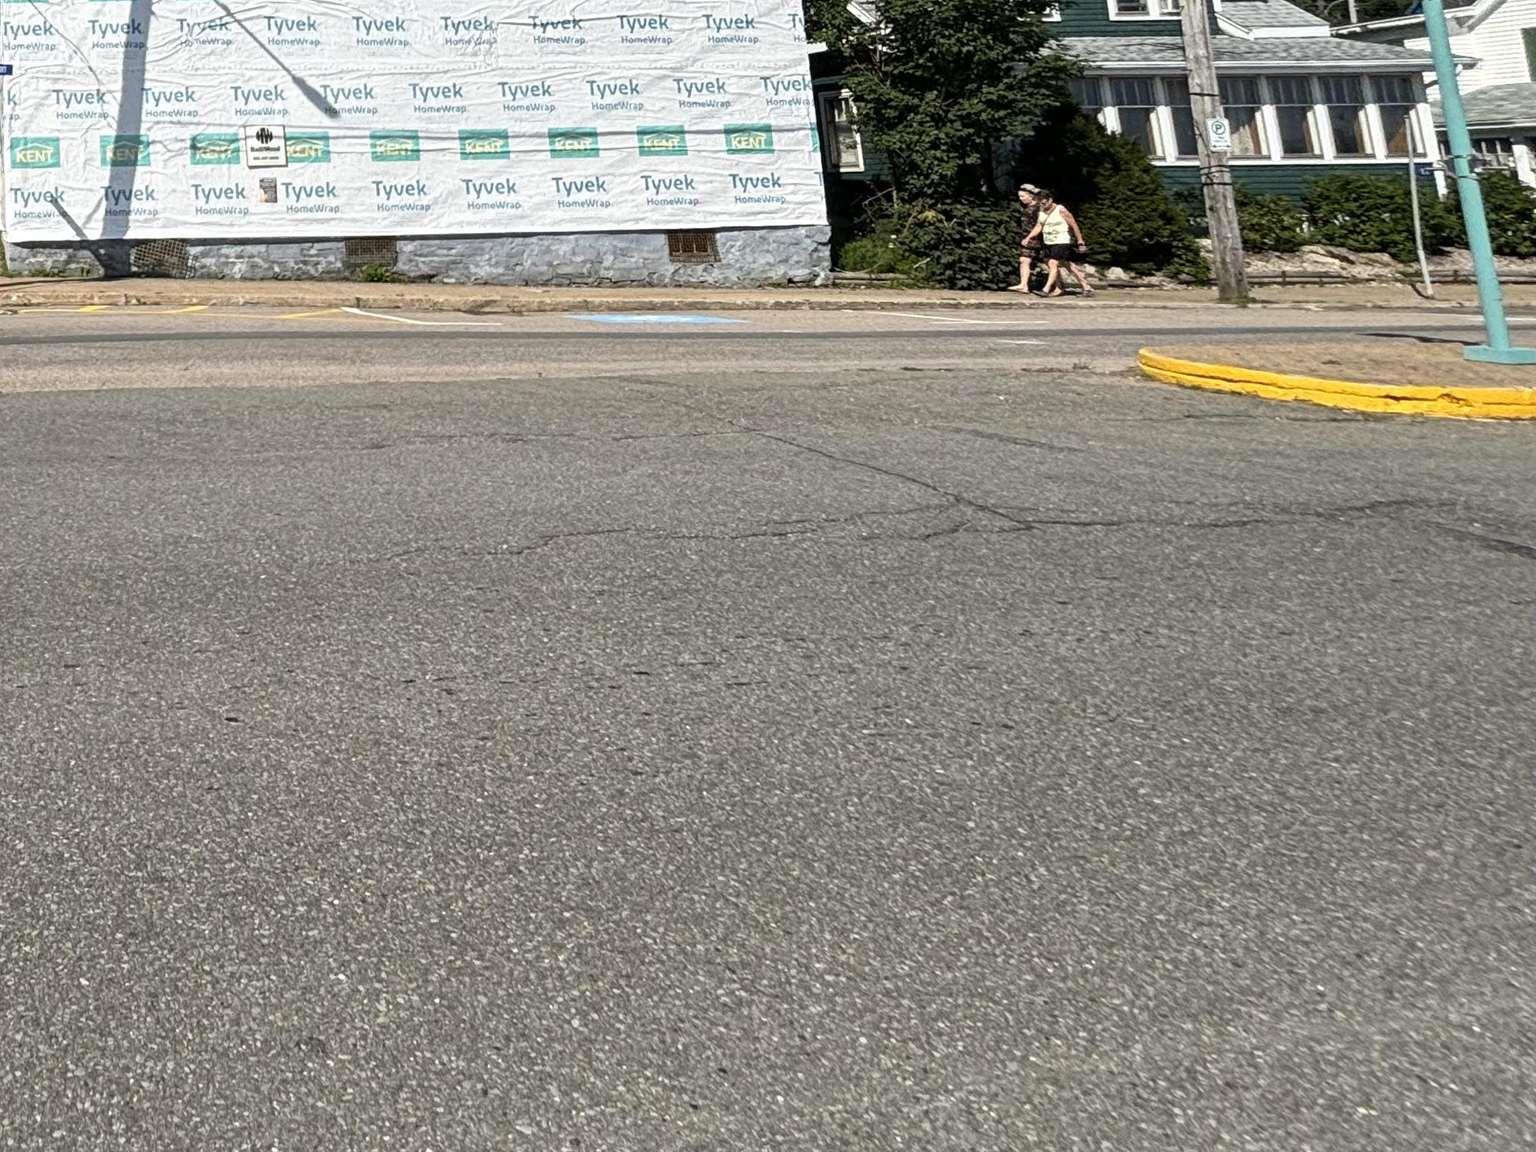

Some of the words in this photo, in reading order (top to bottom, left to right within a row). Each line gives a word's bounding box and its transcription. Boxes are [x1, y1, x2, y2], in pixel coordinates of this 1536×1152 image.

[3, 20, 53, 40] Tyvek
[88, 19, 142, 38] Tyvek
[265, 16, 317, 35] Tyvek
[353, 16, 406, 35] Tyvek
[441, 16, 494, 34] Tyvek
[528, 15, 582, 32] Tyvek
[617, 14, 669, 33] Tyvek
[702, 14, 755, 32] Tyvek
[92, 41, 145, 50] HomeWrap
[268, 38, 320, 47] HomeWrap
[357, 38, 409, 47] HomeWrap
[534, 36, 585, 45] HomeWrap
[621, 35, 672, 44] HomeWrap
[708, 35, 759, 44] HomeWrap
[230, 85, 285, 105] Tyvek
[321, 84, 374, 104] Tyvek
[409, 83, 463, 102] Tyvek
[498, 81, 551, 100] Tyvek
[586, 80, 640, 98] Tyvek
[673, 78, 727, 97] Tyvek
[52, 89, 106, 108] Tyvek
[142, 87, 195, 106] Tyvek
[679, 100, 731, 109] HomeWrap
[146, 109, 199, 118] HomeWrap
[235, 108, 288, 117] HomeWrap
[325, 106, 378, 115] HomeWrap
[414, 104, 467, 113] HomeWrap
[503, 103, 556, 112] HomeWrap
[592, 102, 643, 111] HomeWrap
[56, 111, 109, 120] HomeWrap
[731, 136, 767, 149] KENT
[16, 149, 53, 162] KENT
[371, 180, 427, 199] Tyvek
[462, 179, 517, 198] Tyvek
[552, 177, 607, 196] Tyvek
[640, 175, 695, 194] Tyvek
[729, 173, 782, 193] Tyvek
[10, 186, 64, 208] Tyvek
[100, 185, 156, 206] Tyvek
[191, 184, 246, 203] Tyvek
[281, 182, 336, 202] Tyvek
[735, 196, 786, 204] HomeWrap
[195, 206, 249, 215] HomeWrap
[286, 205, 340, 213] HomeWrap
[376, 203, 431, 212] HomeWrap
[467, 201, 521, 210] HomeWrap
[558, 200, 611, 209] HomeWrap
[647, 198, 698, 207] HomeWrap
[105, 208, 158, 217] HomeWrap
